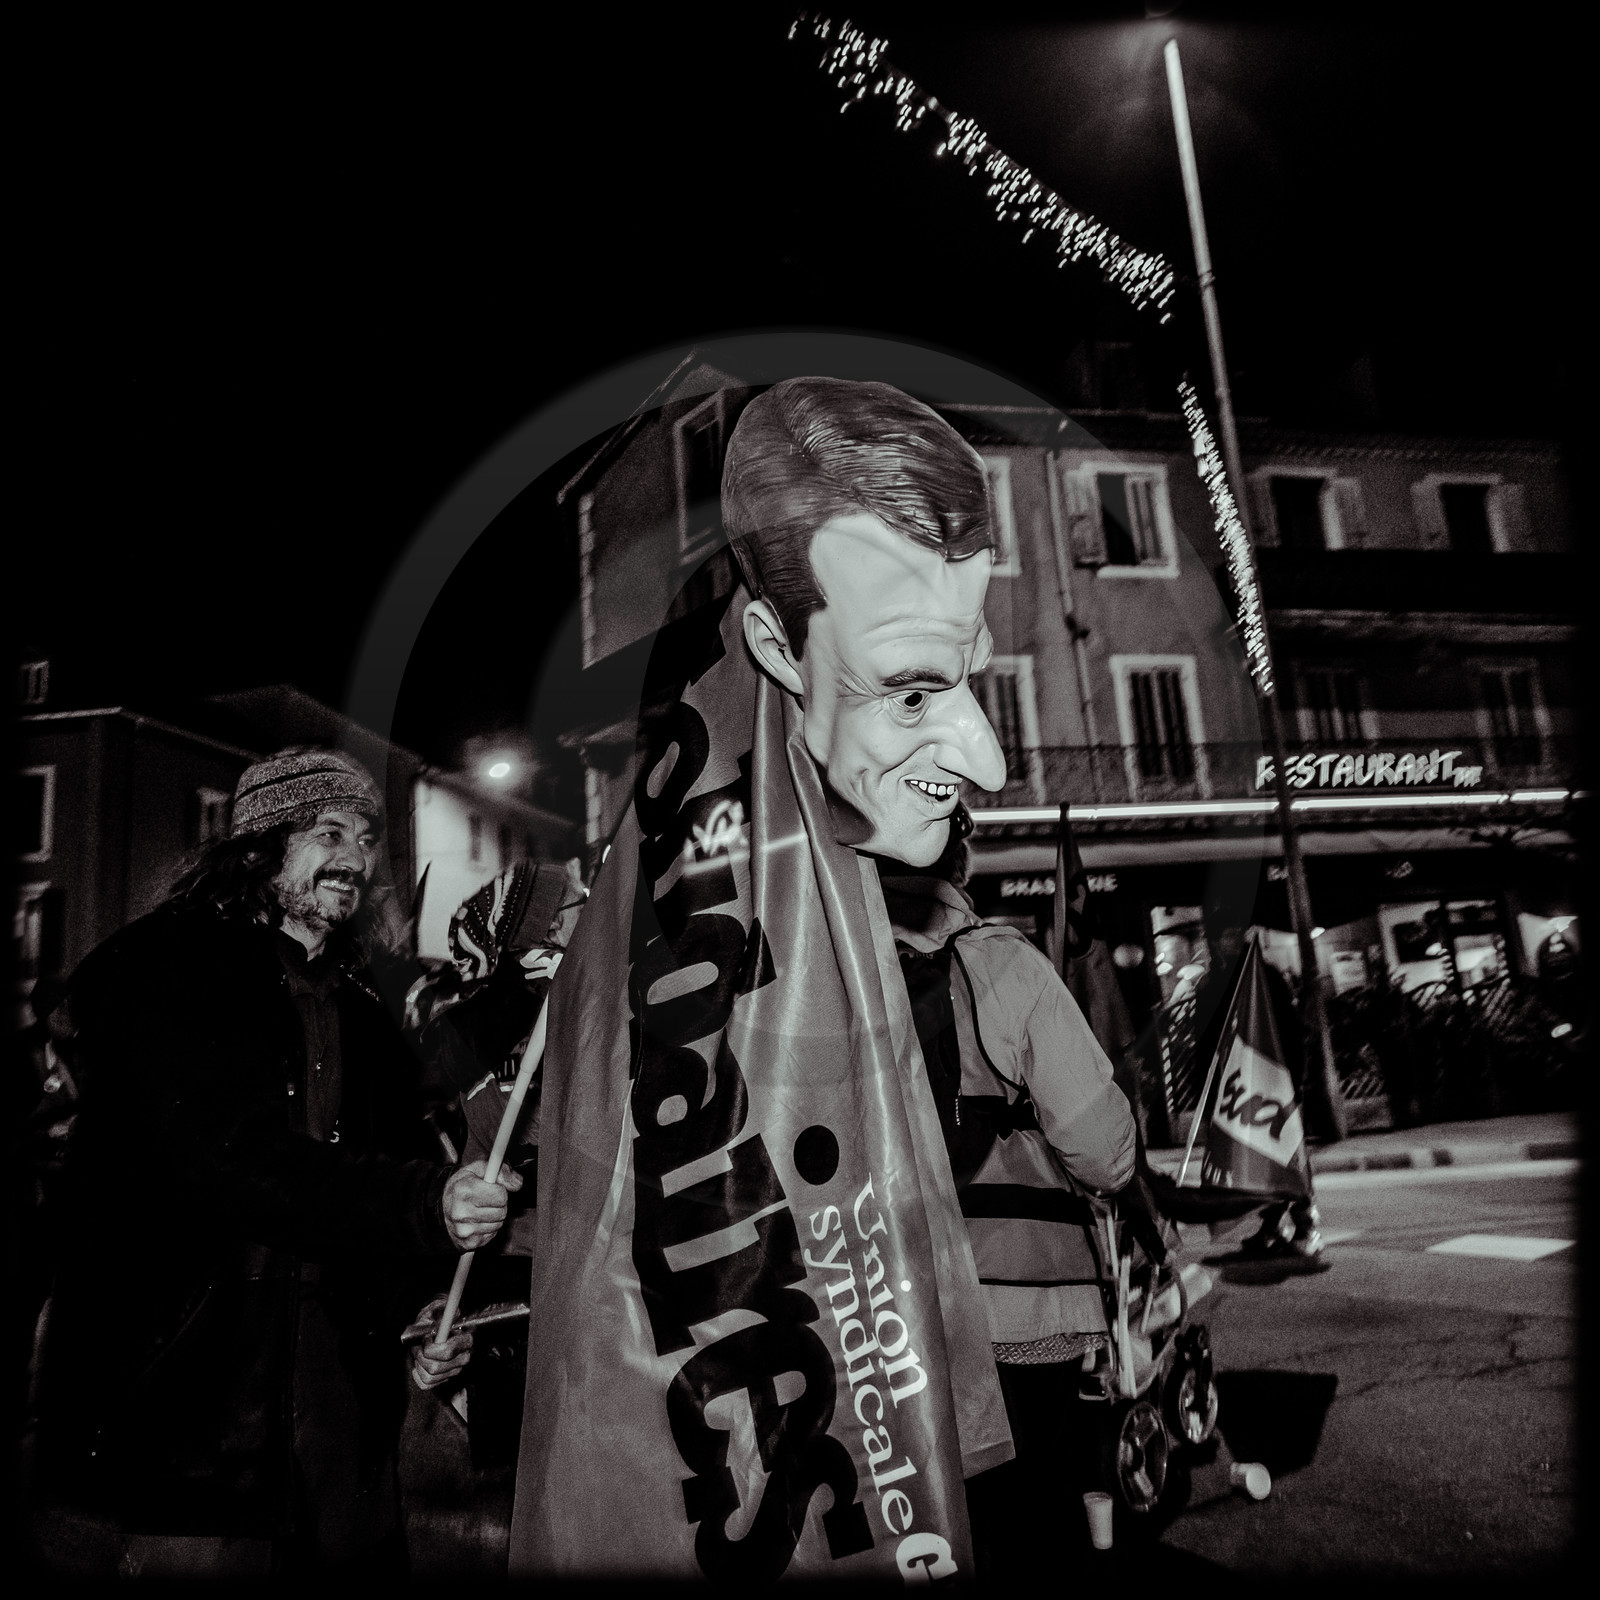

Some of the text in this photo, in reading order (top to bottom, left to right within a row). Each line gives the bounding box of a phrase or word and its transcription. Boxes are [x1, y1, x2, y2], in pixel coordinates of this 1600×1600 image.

[1255, 748, 1463, 790] RESTAURANT
[625, 608, 875, 1588] olidaires
[803, 1205, 918, 1535] syndicale
[853, 1172, 928, 1409] Union
